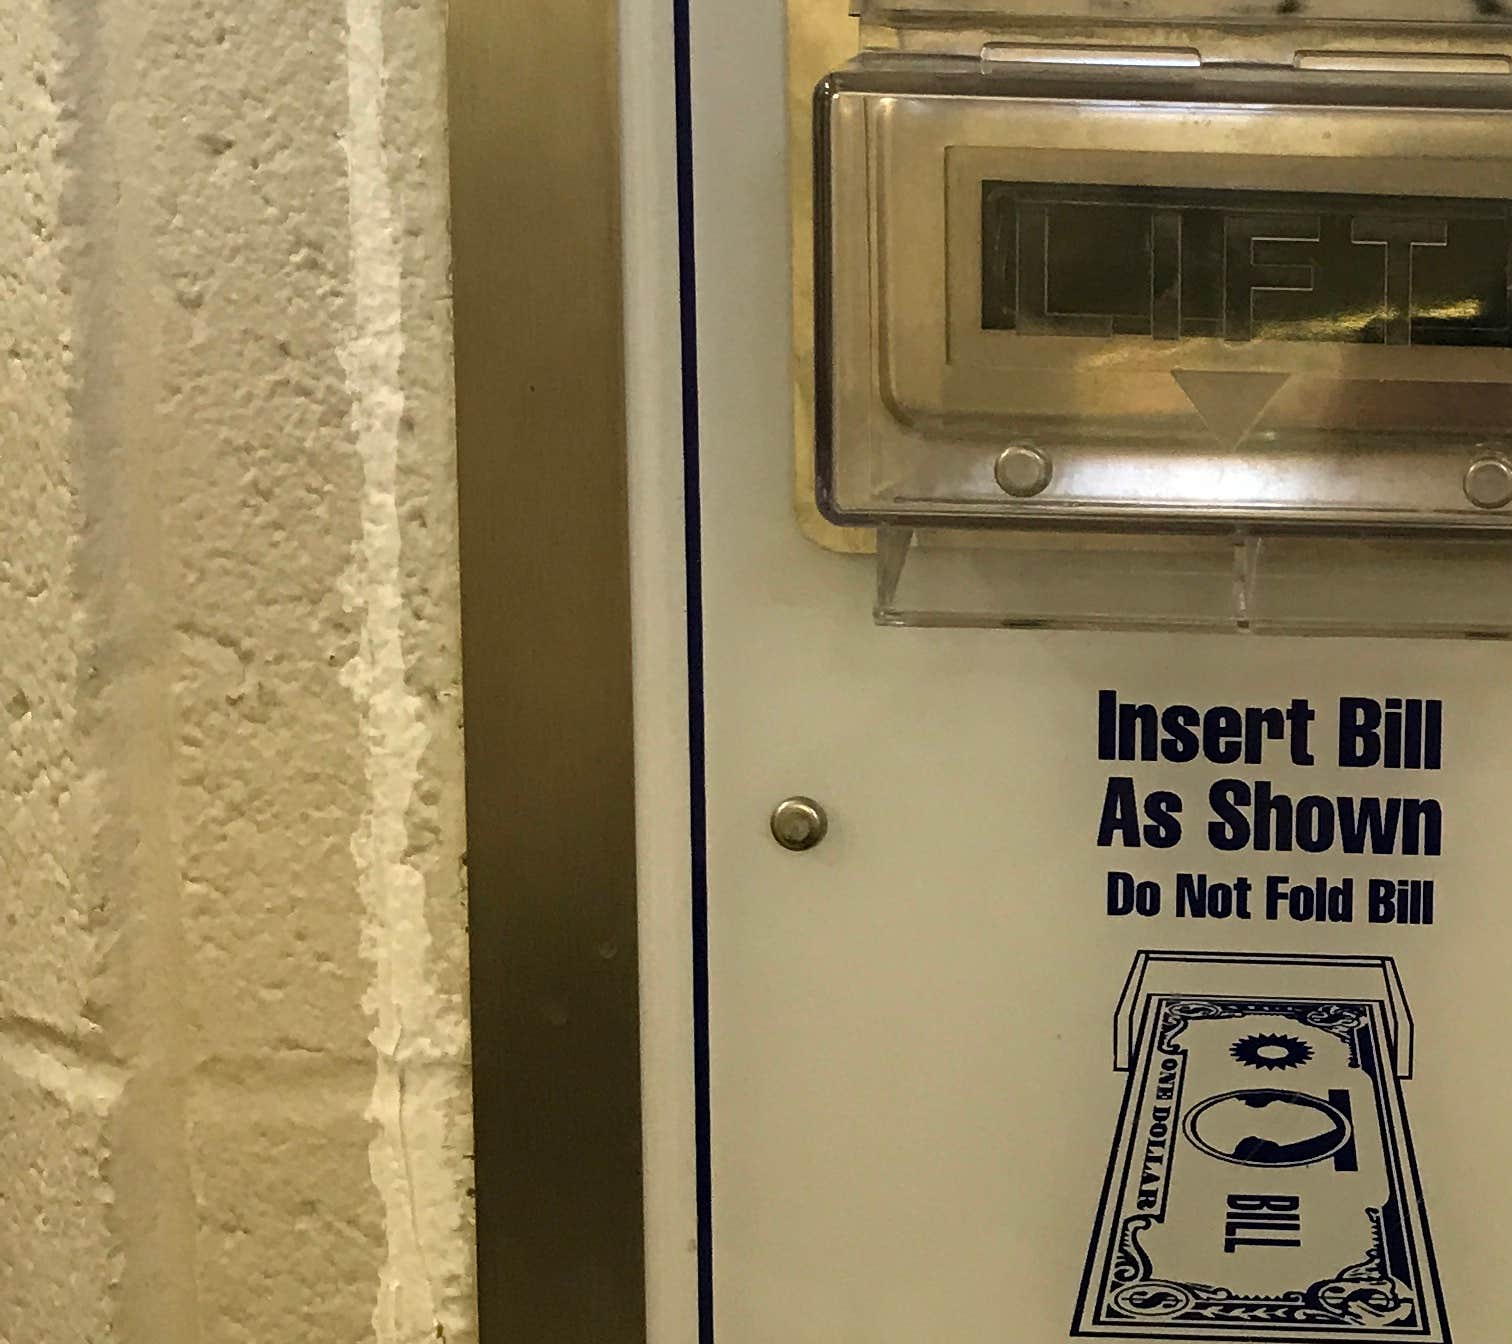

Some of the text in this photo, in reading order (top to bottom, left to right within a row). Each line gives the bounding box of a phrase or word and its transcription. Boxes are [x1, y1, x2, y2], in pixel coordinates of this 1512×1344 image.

[1016, 208, 1448, 346] LIFT
[1097, 689, 1443, 771] Insert Bill
[1096, 776, 1442, 856] As Shown
[1106, 871, 1434, 925] Do Not Fold Bill
[1136, 1058, 1178, 1211] ONE DOLLAR
[1223, 1193, 1302, 1254] BILL
